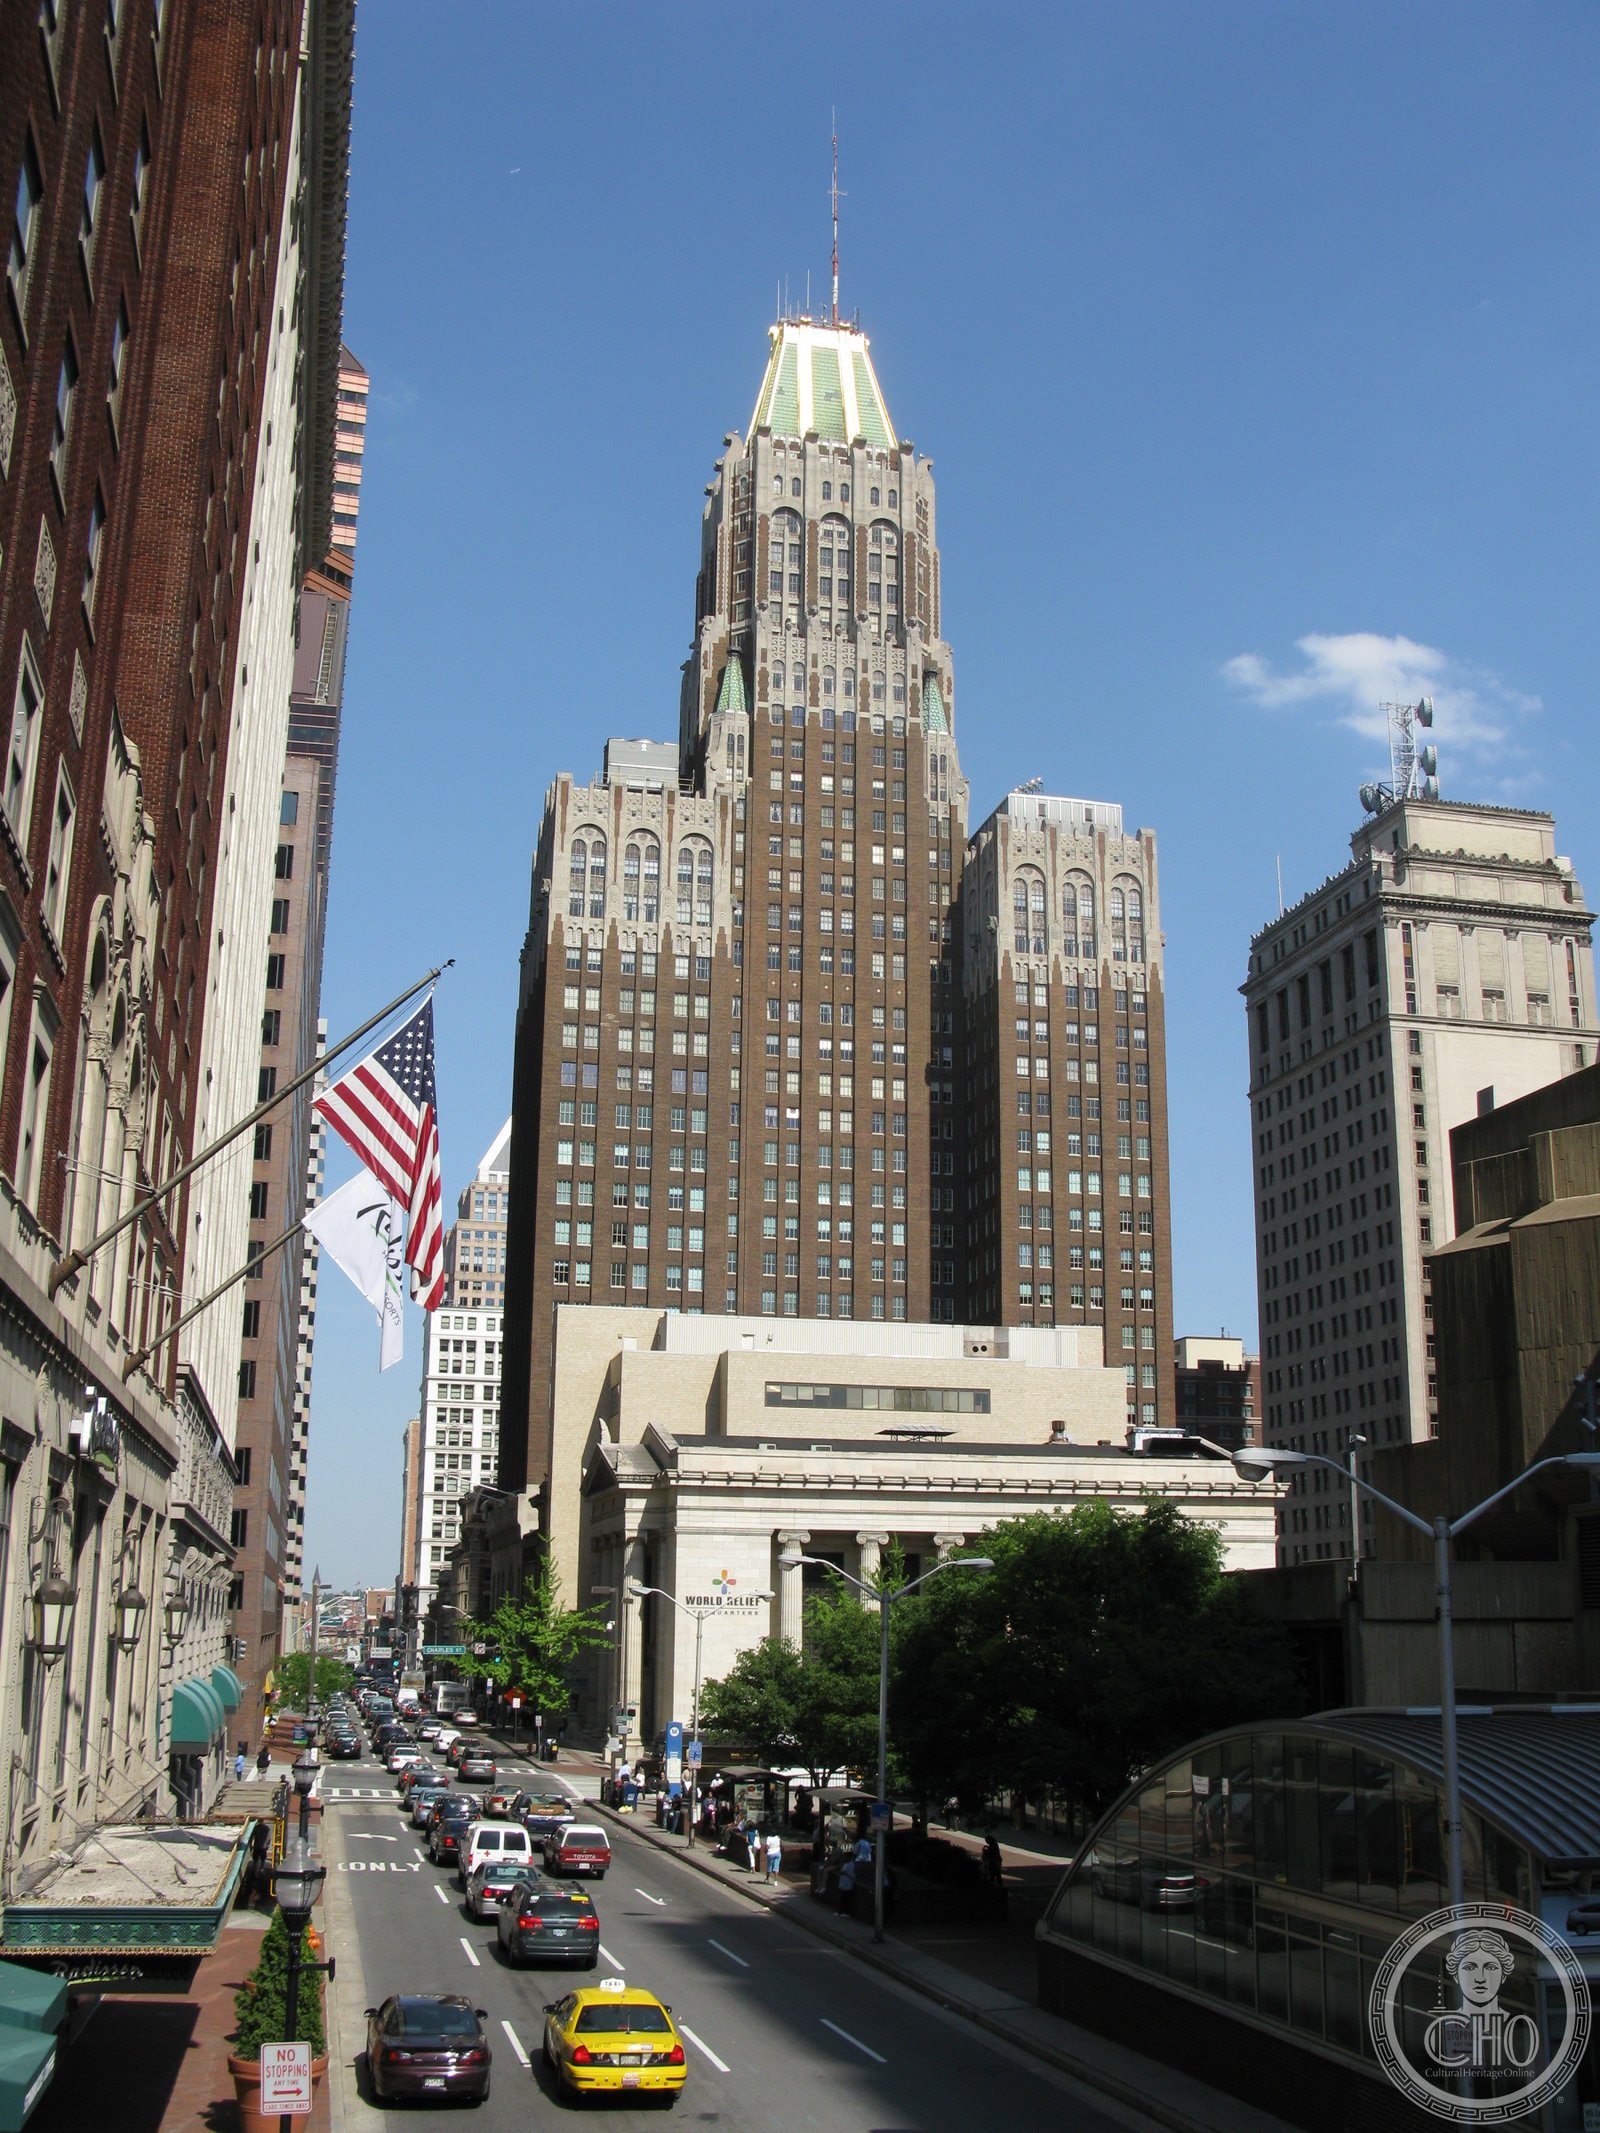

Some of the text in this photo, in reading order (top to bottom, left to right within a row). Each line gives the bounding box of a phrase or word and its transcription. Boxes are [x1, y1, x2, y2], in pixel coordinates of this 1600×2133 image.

[685, 1595, 760, 1607] WORLD RELIEF
[50, 1958, 144, 1980] Radisson
[1446, 2030, 1474, 2041] STOPPIN
[277, 2049, 296, 2062] NO
[266, 2064, 308, 2079] STOPPING
